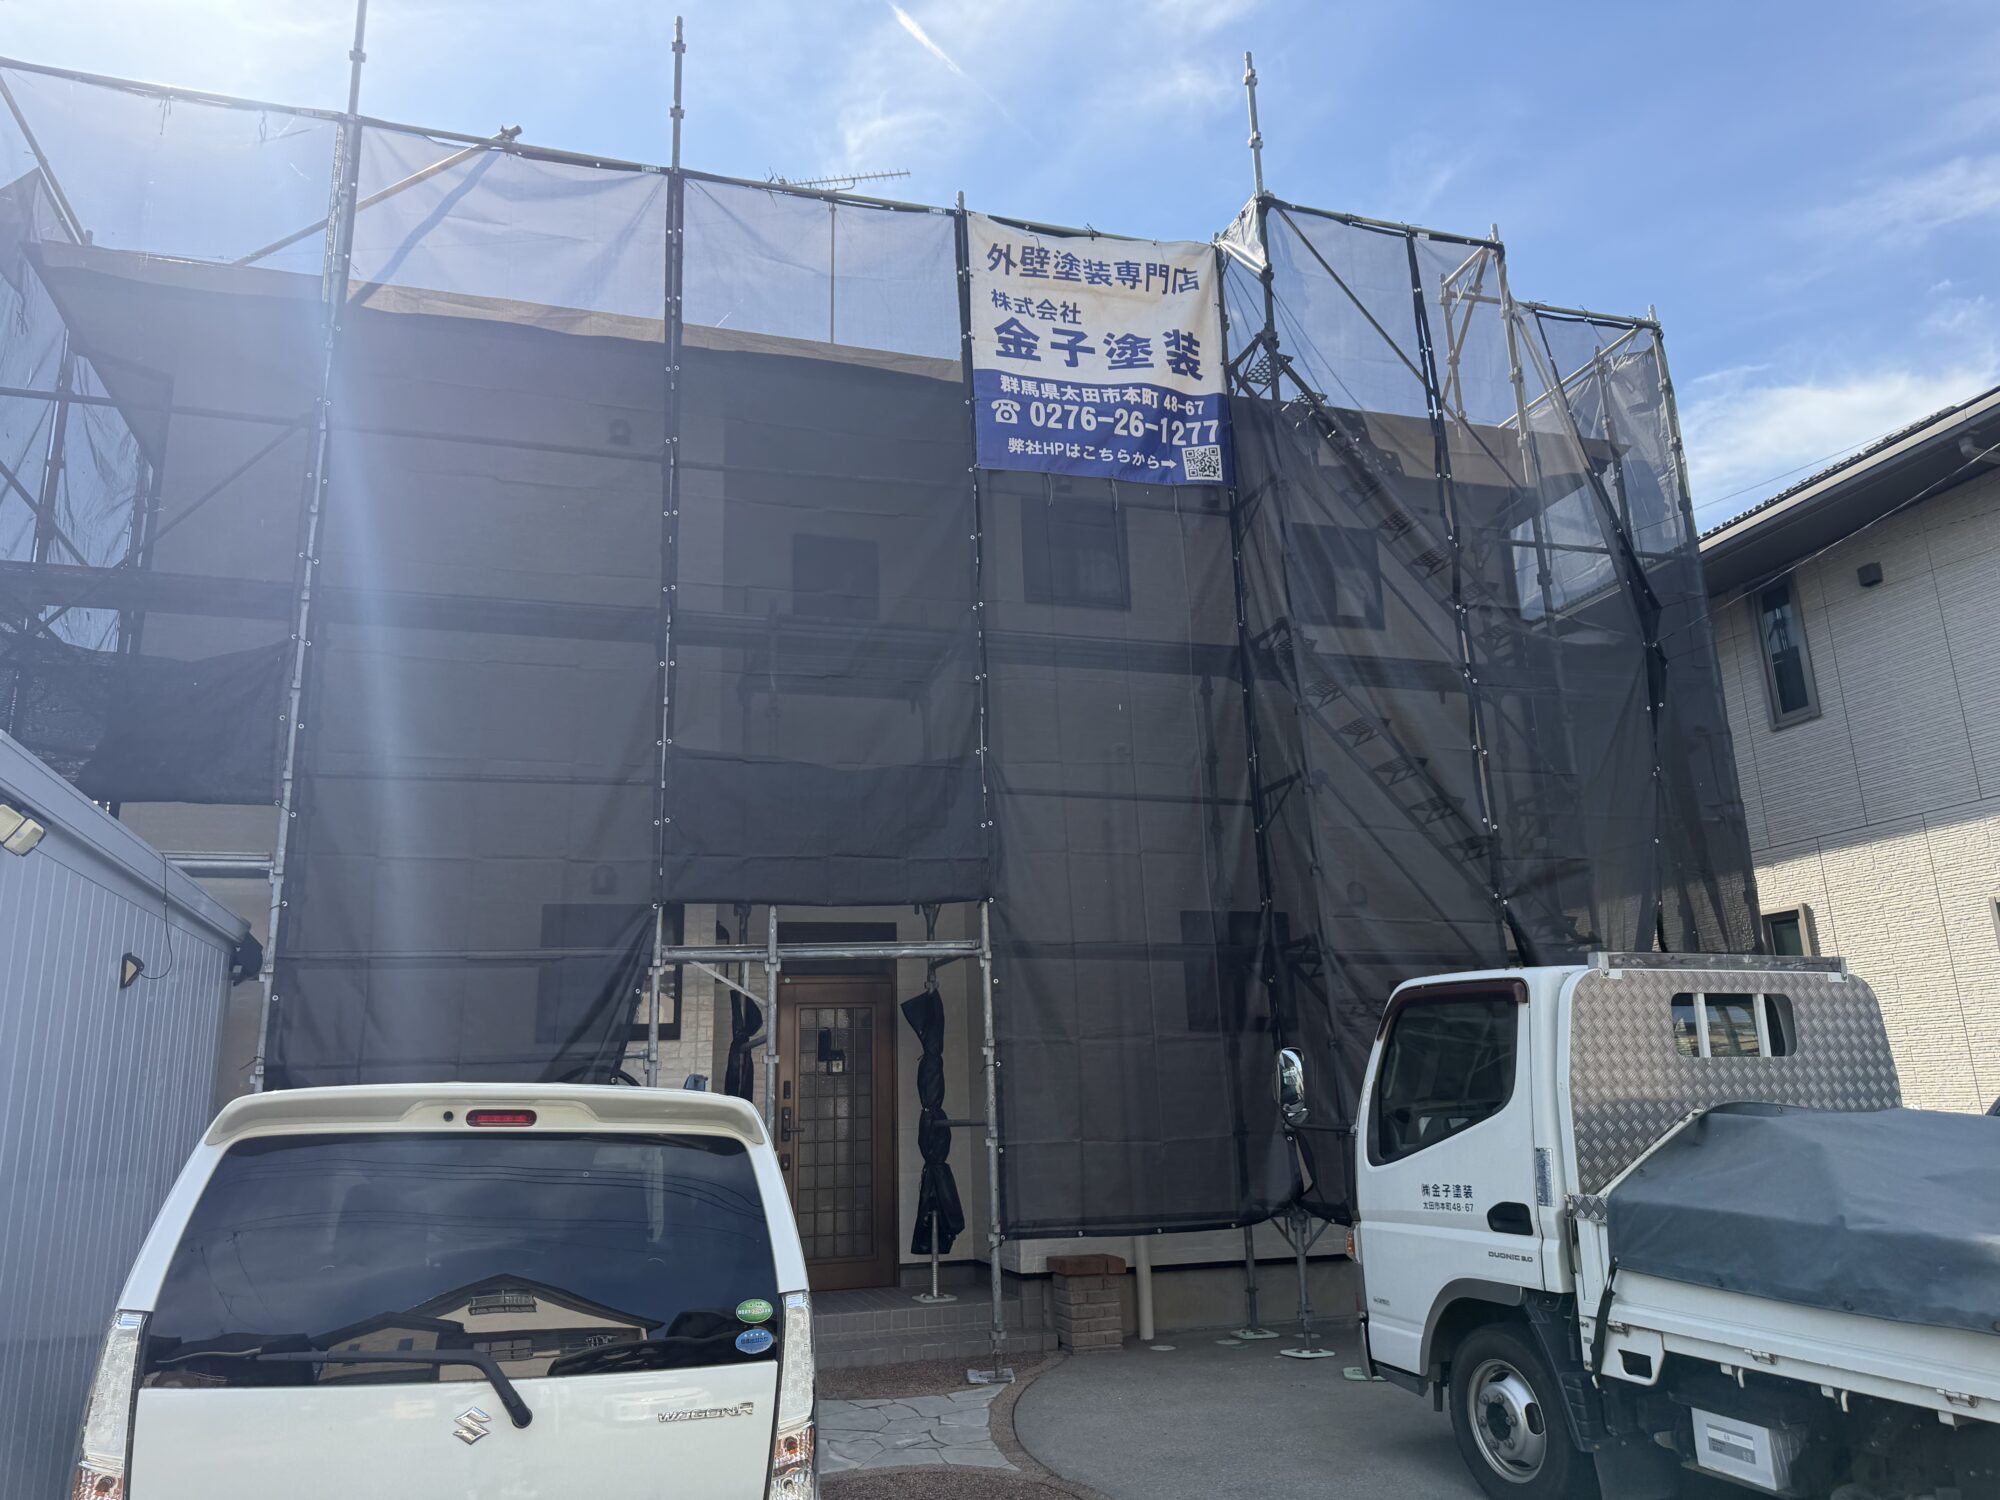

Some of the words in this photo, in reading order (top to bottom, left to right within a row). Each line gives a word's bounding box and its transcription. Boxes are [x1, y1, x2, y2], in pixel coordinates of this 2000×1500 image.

[987, 242, 1200, 295] 外壁塗装専門店
[990, 288, 1082, 325] 株式会社
[1000, 374, 1159, 408] 群馬県太田市本町
[1163, 394, 1205, 415] 48-67
[1029, 403, 1219, 446] 0276-26-1277
[1008, 437, 1160, 469] 弊社HPはこちらから
